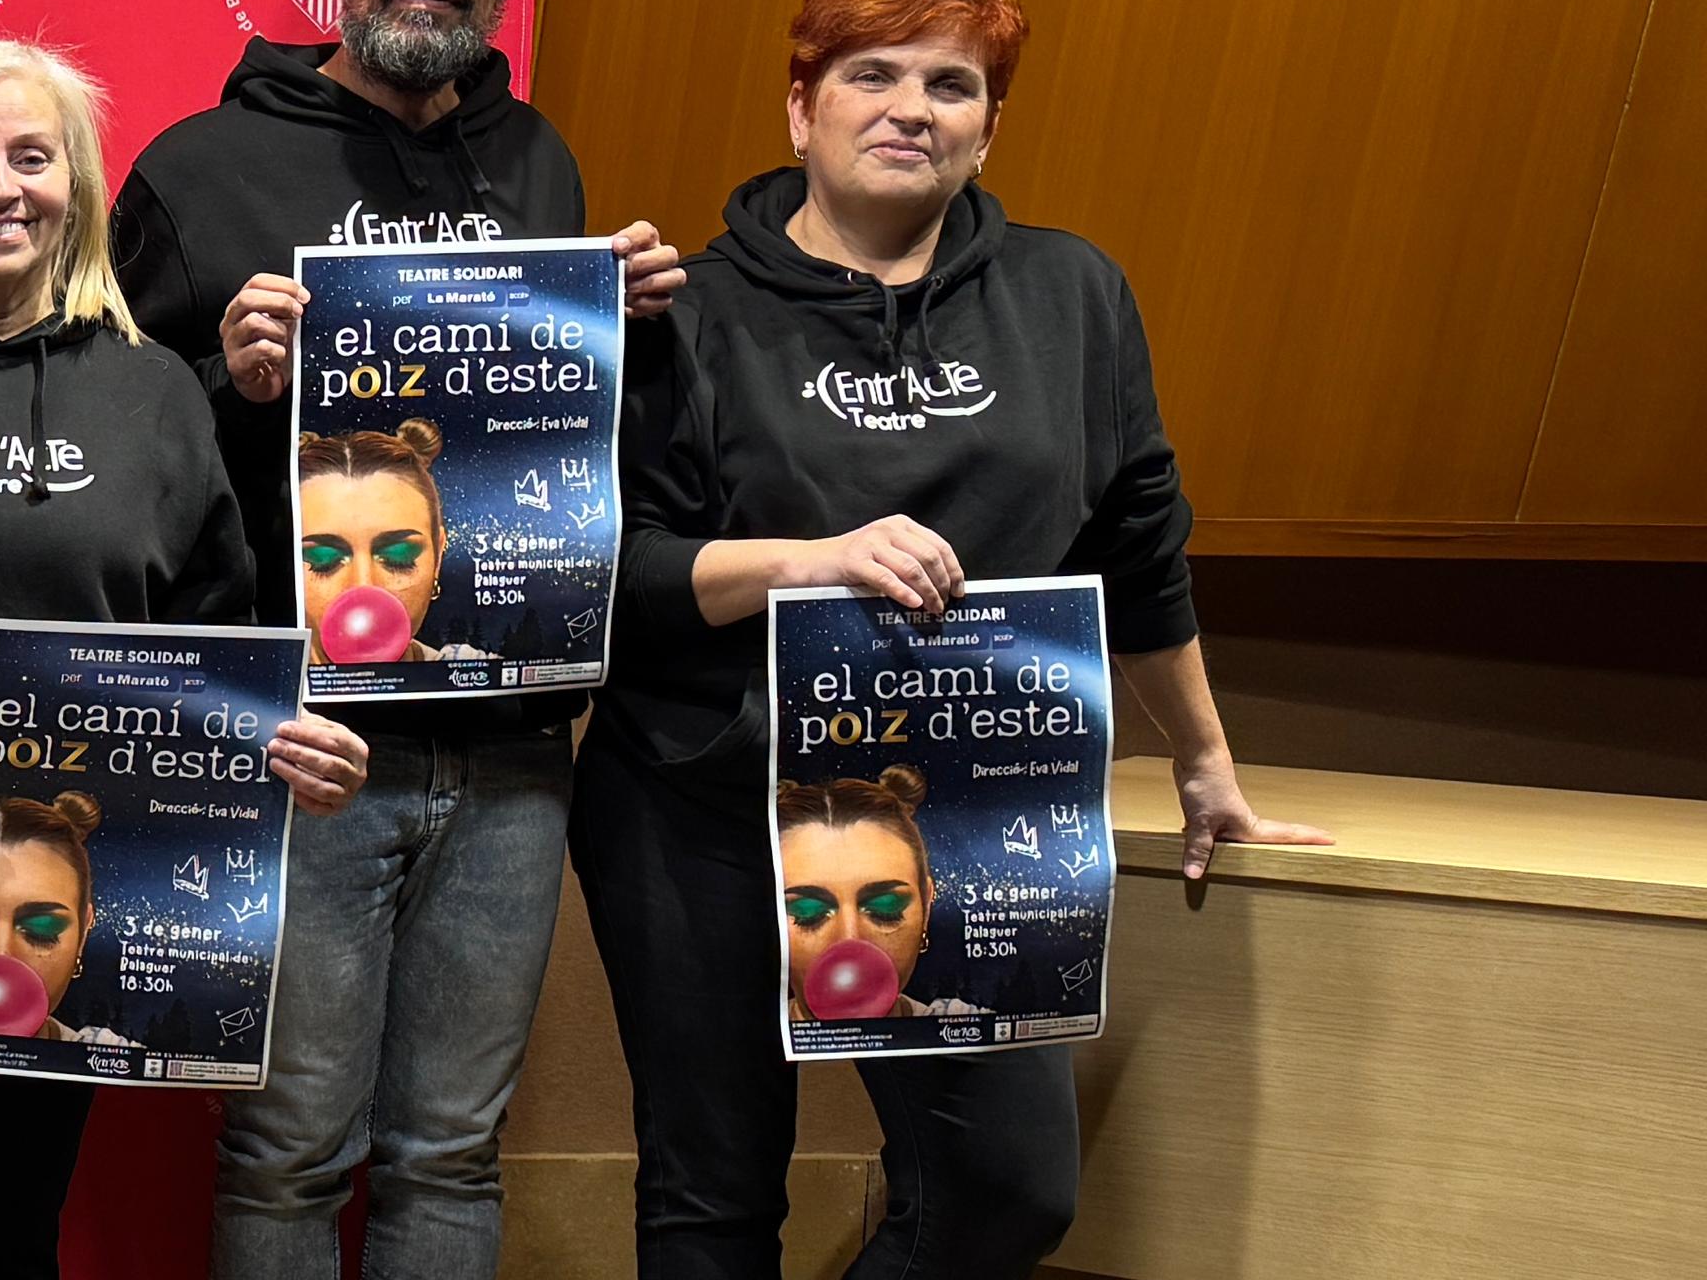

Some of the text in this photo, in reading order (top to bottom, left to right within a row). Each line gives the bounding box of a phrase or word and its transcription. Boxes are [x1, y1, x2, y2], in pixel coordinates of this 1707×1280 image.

[398, 266, 522, 282] TEATRE SOLIDARI
[335, 314, 582, 357] el camí de
[321, 355, 597, 407] polz d'estel
[847, 406, 926, 431] Teatre
[878, 608, 1006, 625] TEATRE SOLIDARI
[70, 648, 200, 667] TEATRE SOLIDARI
[813, 656, 1069, 702] el camí de
[59, 701, 181, 738] camí
[203, 703, 257, 741] de
[798, 698, 1088, 754] polz d'estel
[110, 739, 270, 784] d'estel
